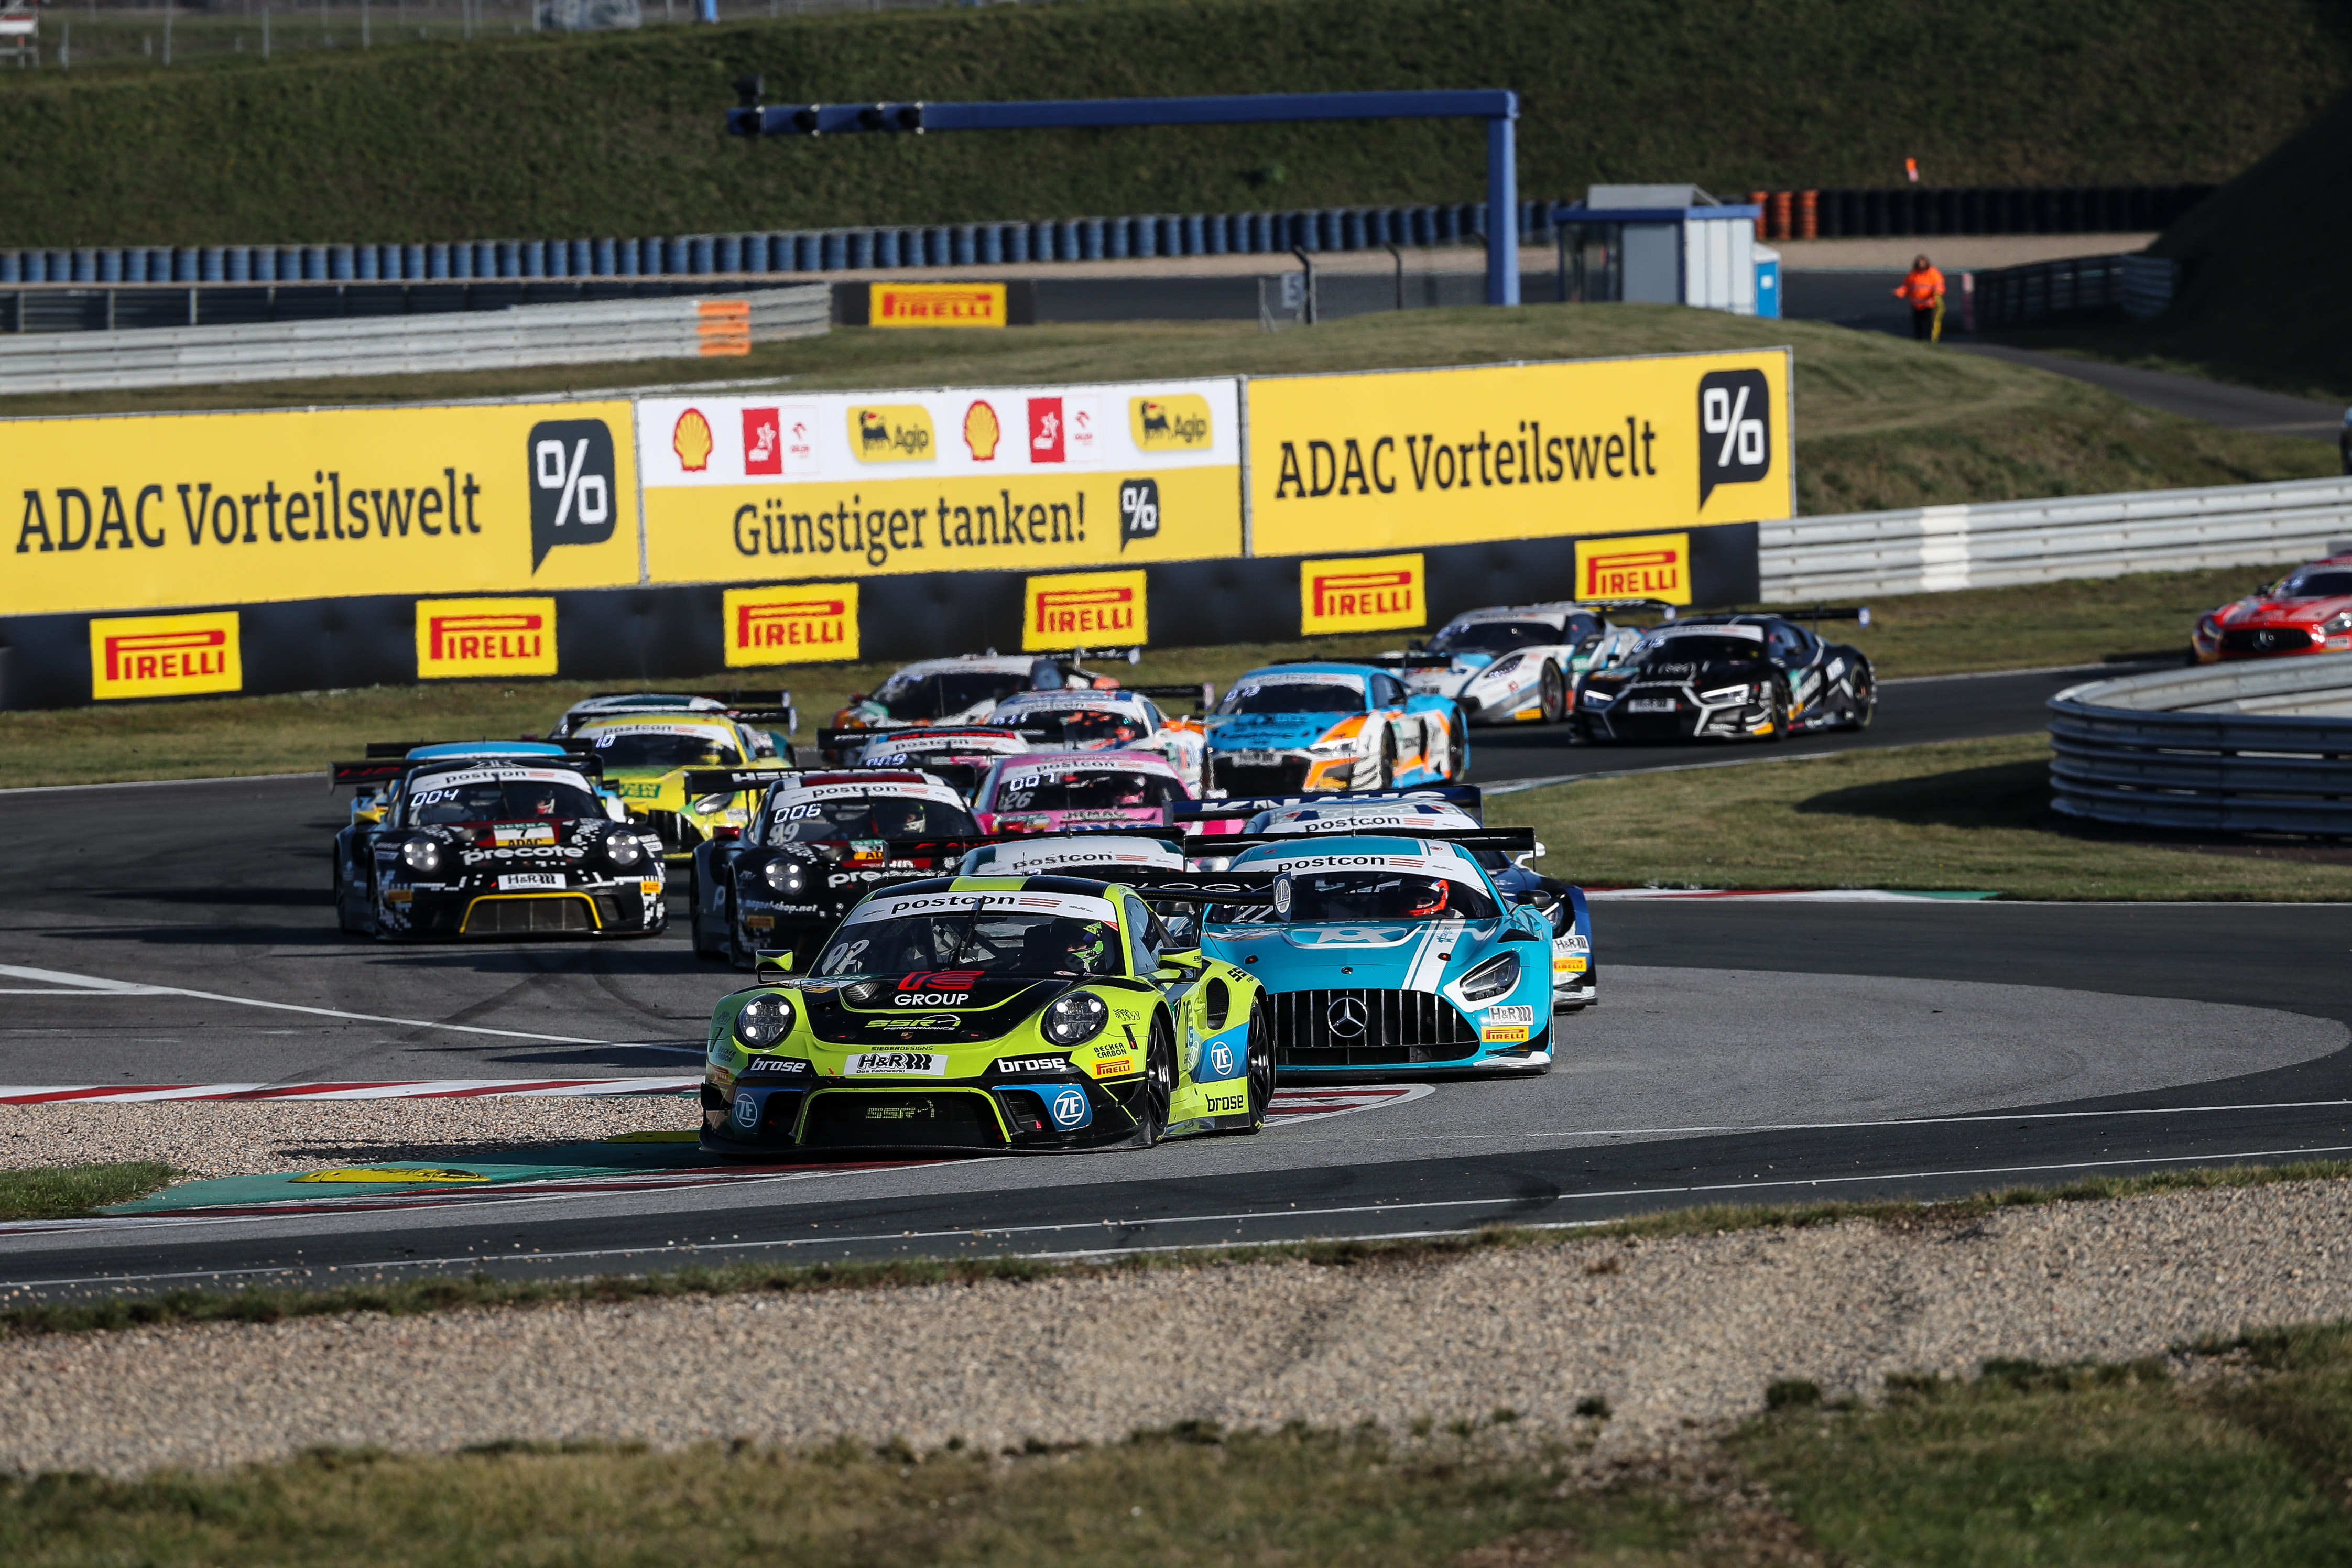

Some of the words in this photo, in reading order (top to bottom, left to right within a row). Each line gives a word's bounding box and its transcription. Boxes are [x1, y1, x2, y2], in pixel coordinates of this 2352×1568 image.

[1174, 412, 1207, 444] Agip
[894, 423, 929, 455] Agip
[1275, 436, 1397, 499] ADAC
[1407, 417, 1656, 491] Vorteilswelt
[16, 484, 165, 553] ADAC
[177, 467, 482, 546] Vorteilswelt
[734, 493, 927, 566] Günstiger
[937, 489, 1085, 547] tanken!
[1587, 550, 1676, 594] PIRELLI
[1312, 571, 1411, 616] PIRELLI
[1036, 587, 1132, 633] PIRELLI
[738, 600, 844, 647] PIRELLI
[430, 615, 541, 660] PIRELLI
[105, 629, 225, 681] PIRELLI
[445, 769, 526, 784] postcon
[410, 788, 459, 807] 004
[812, 786, 898, 798] postcon
[774, 803, 822, 824] 006
[1305, 814, 1400, 832] postcon
[463, 845, 585, 866] precote
[1012, 853, 1113, 870] postcon
[1278, 856, 1385, 872] postcon
[891, 895, 1015, 914] postcon
[894, 993, 969, 1006] GROUP
[864, 1019, 937, 1028] SSR
[1491, 1007, 1517, 1021] H&R
[1486, 1029, 1524, 1039] PIRELLI
[1093, 1042, 1125, 1053] BECKER
[1097, 1049, 1127, 1058] CARBON
[750, 1058, 806, 1072] brose
[858, 1053, 906, 1069] H&R
[997, 1058, 1067, 1073] brose
[1096, 1060, 1130, 1075] PIRELLI
[1212, 1046, 1233, 1071] ZF
[736, 1099, 756, 1121] ZF
[1054, 1094, 1084, 1121] ZF
[1205, 1094, 1244, 1112] brose
